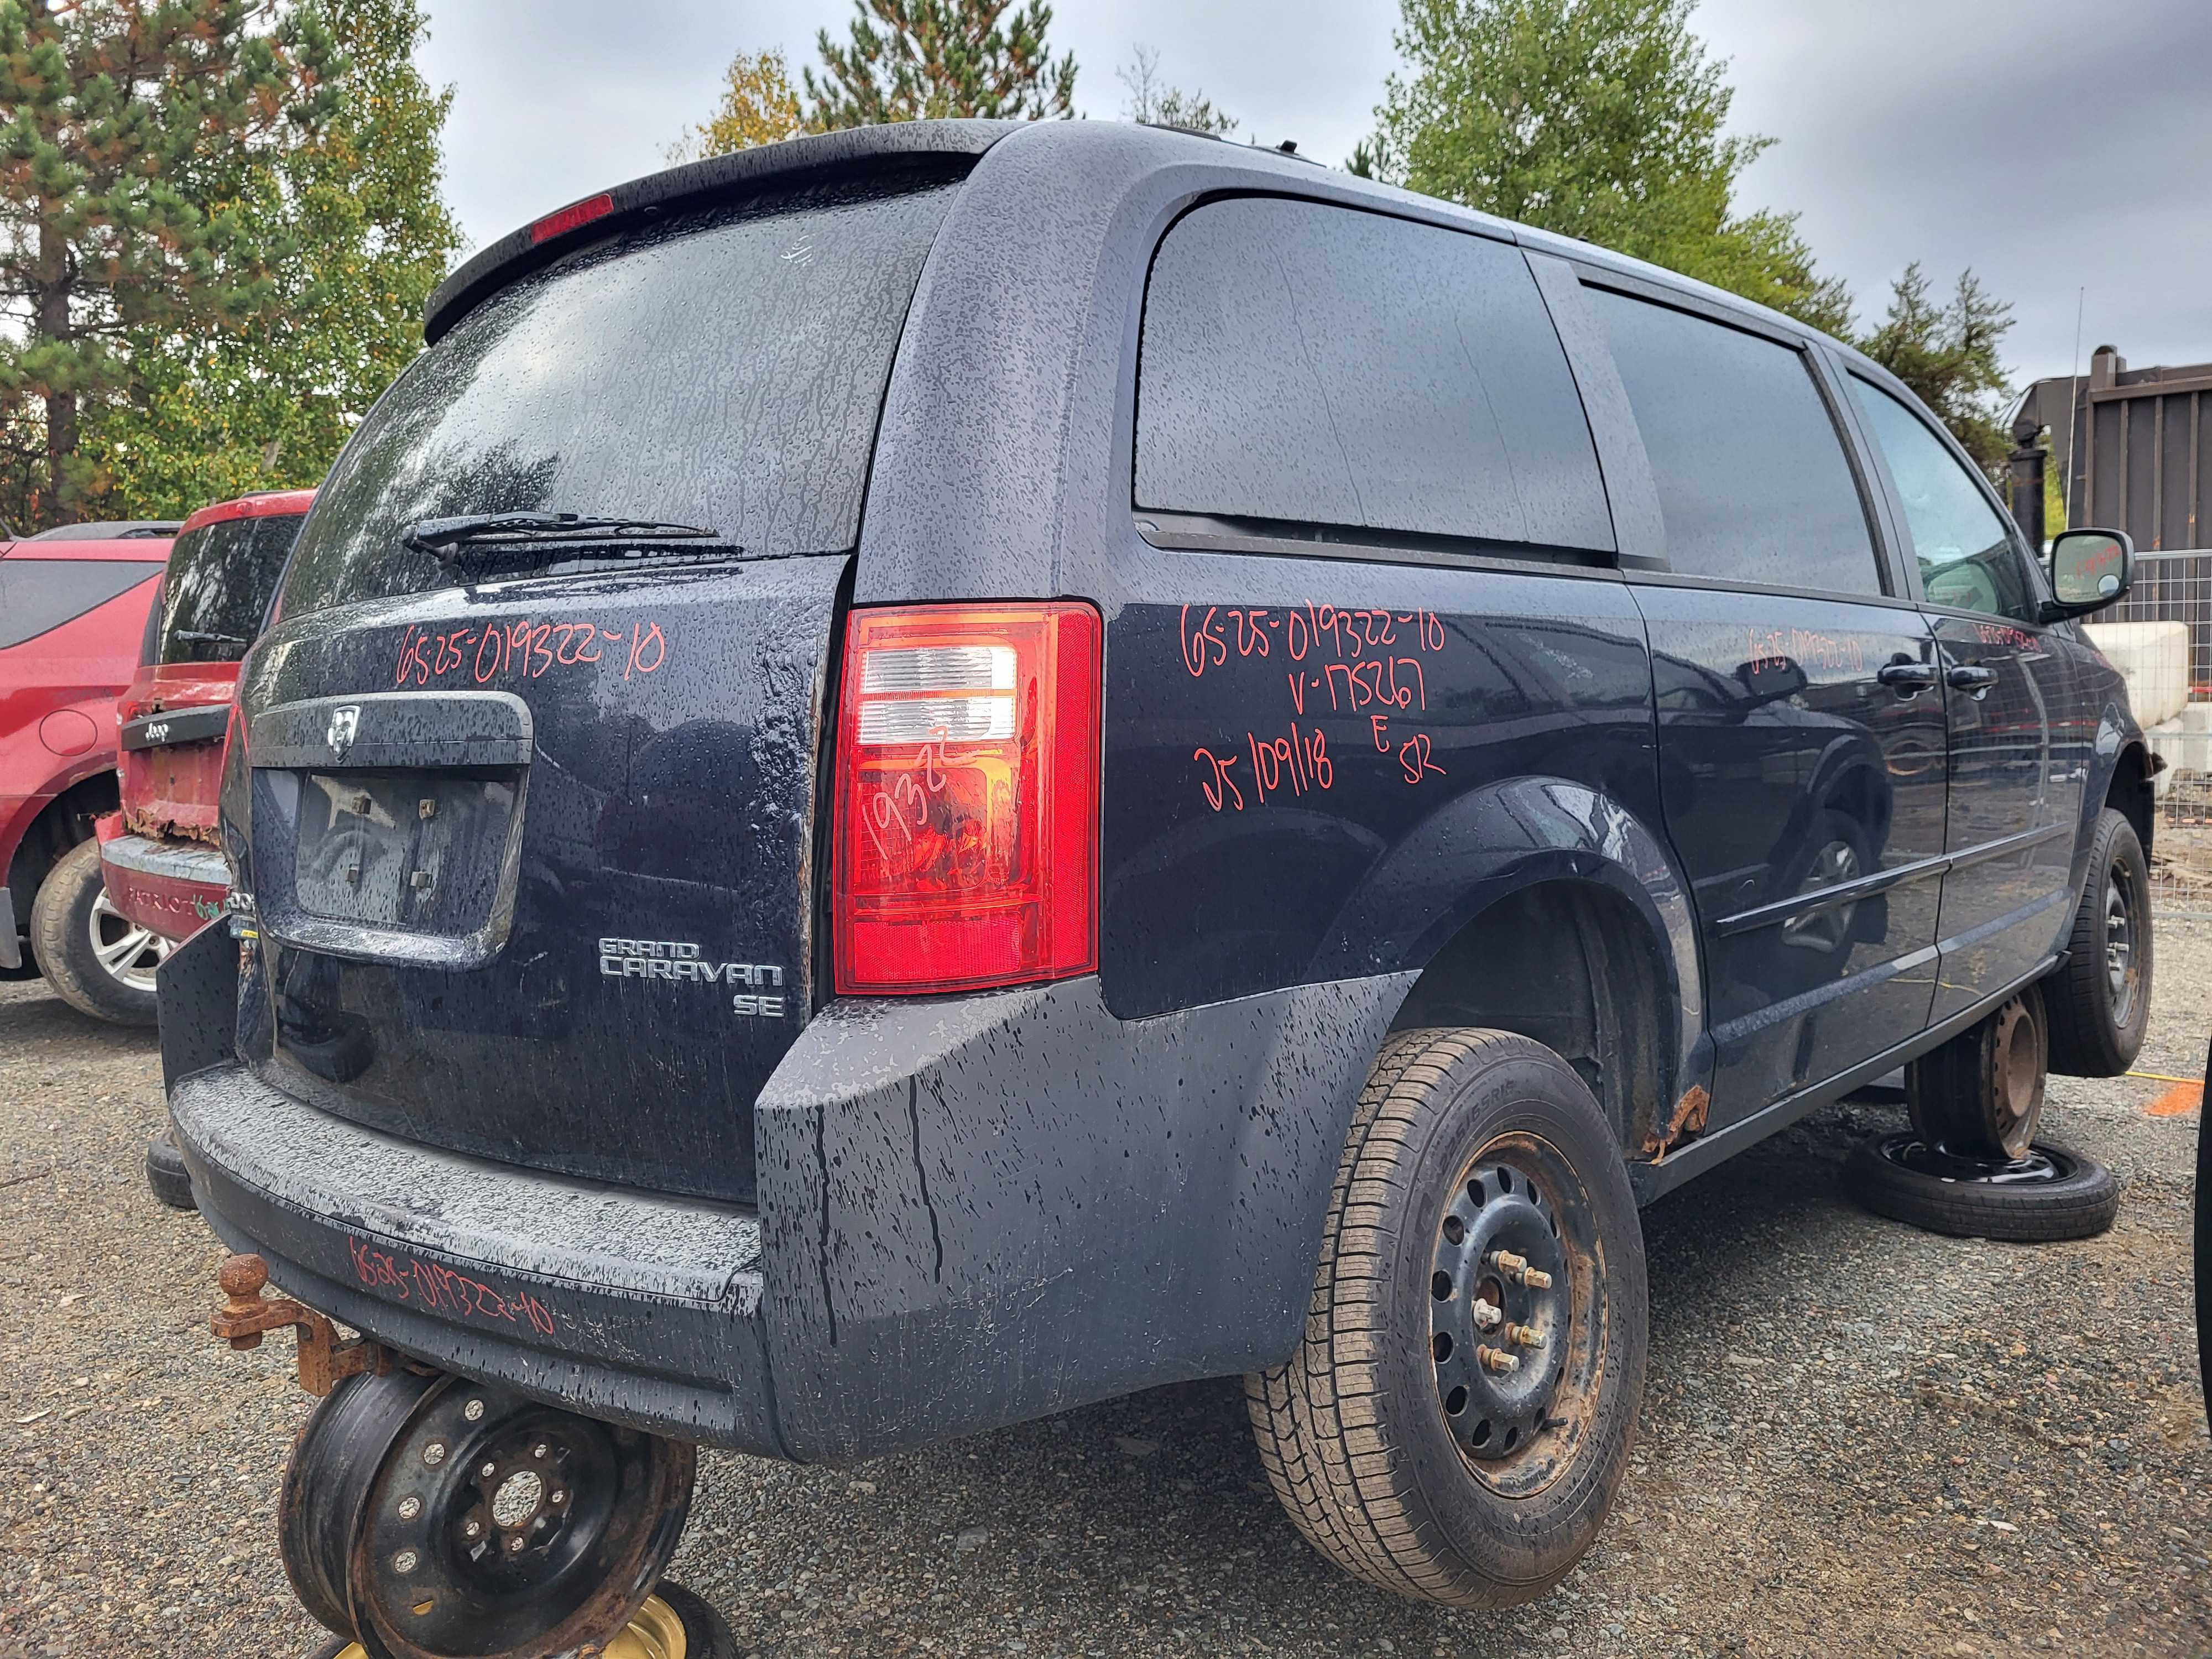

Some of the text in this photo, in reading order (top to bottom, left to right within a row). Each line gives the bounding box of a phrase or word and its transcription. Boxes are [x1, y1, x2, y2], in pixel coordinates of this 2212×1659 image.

[128, 885, 196, 916] PATRIOT
[598, 937, 700, 958] GRAND
[599, 956, 784, 986] CARAVAN
[733, 995, 784, 1017] SE
